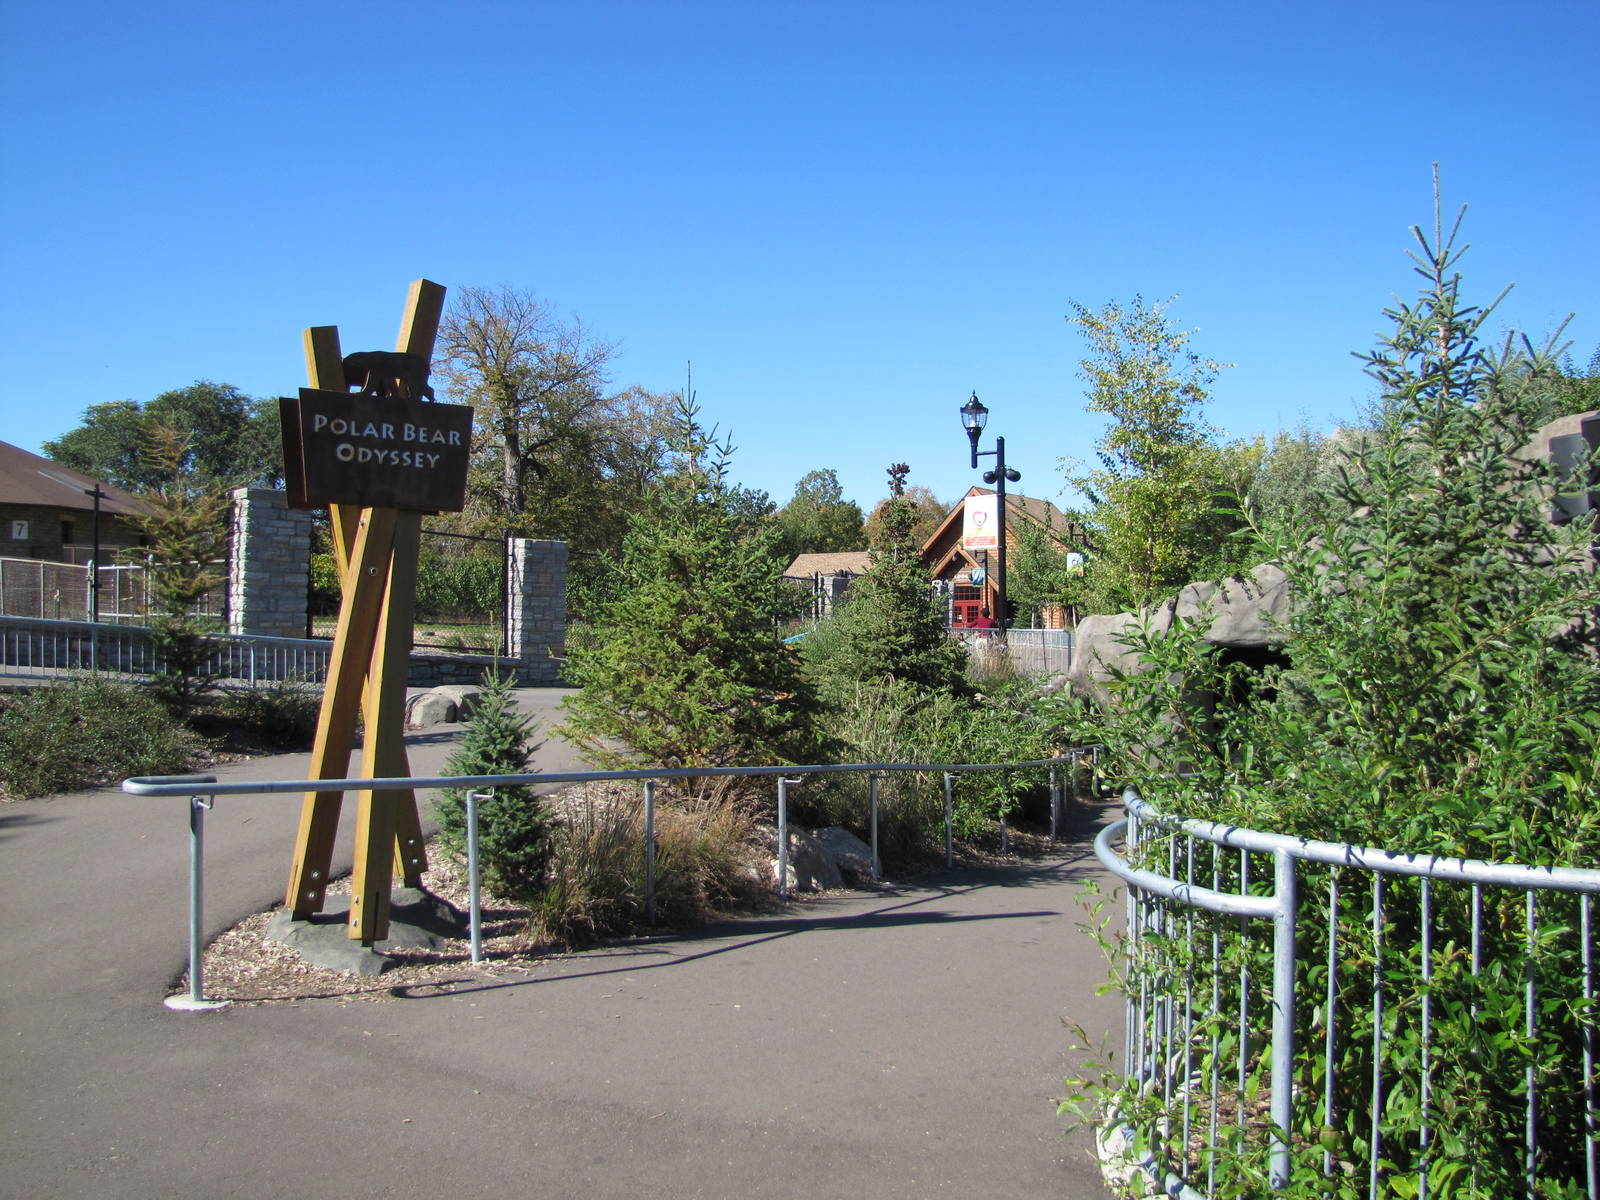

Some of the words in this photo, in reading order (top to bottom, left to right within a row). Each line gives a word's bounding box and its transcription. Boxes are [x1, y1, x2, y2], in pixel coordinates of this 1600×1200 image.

[314, 414, 395, 439] POLAR
[404, 423, 461, 446] BEAR
[336, 443, 440, 468] ODYSSEY
[16, 522, 25, 537] 7
